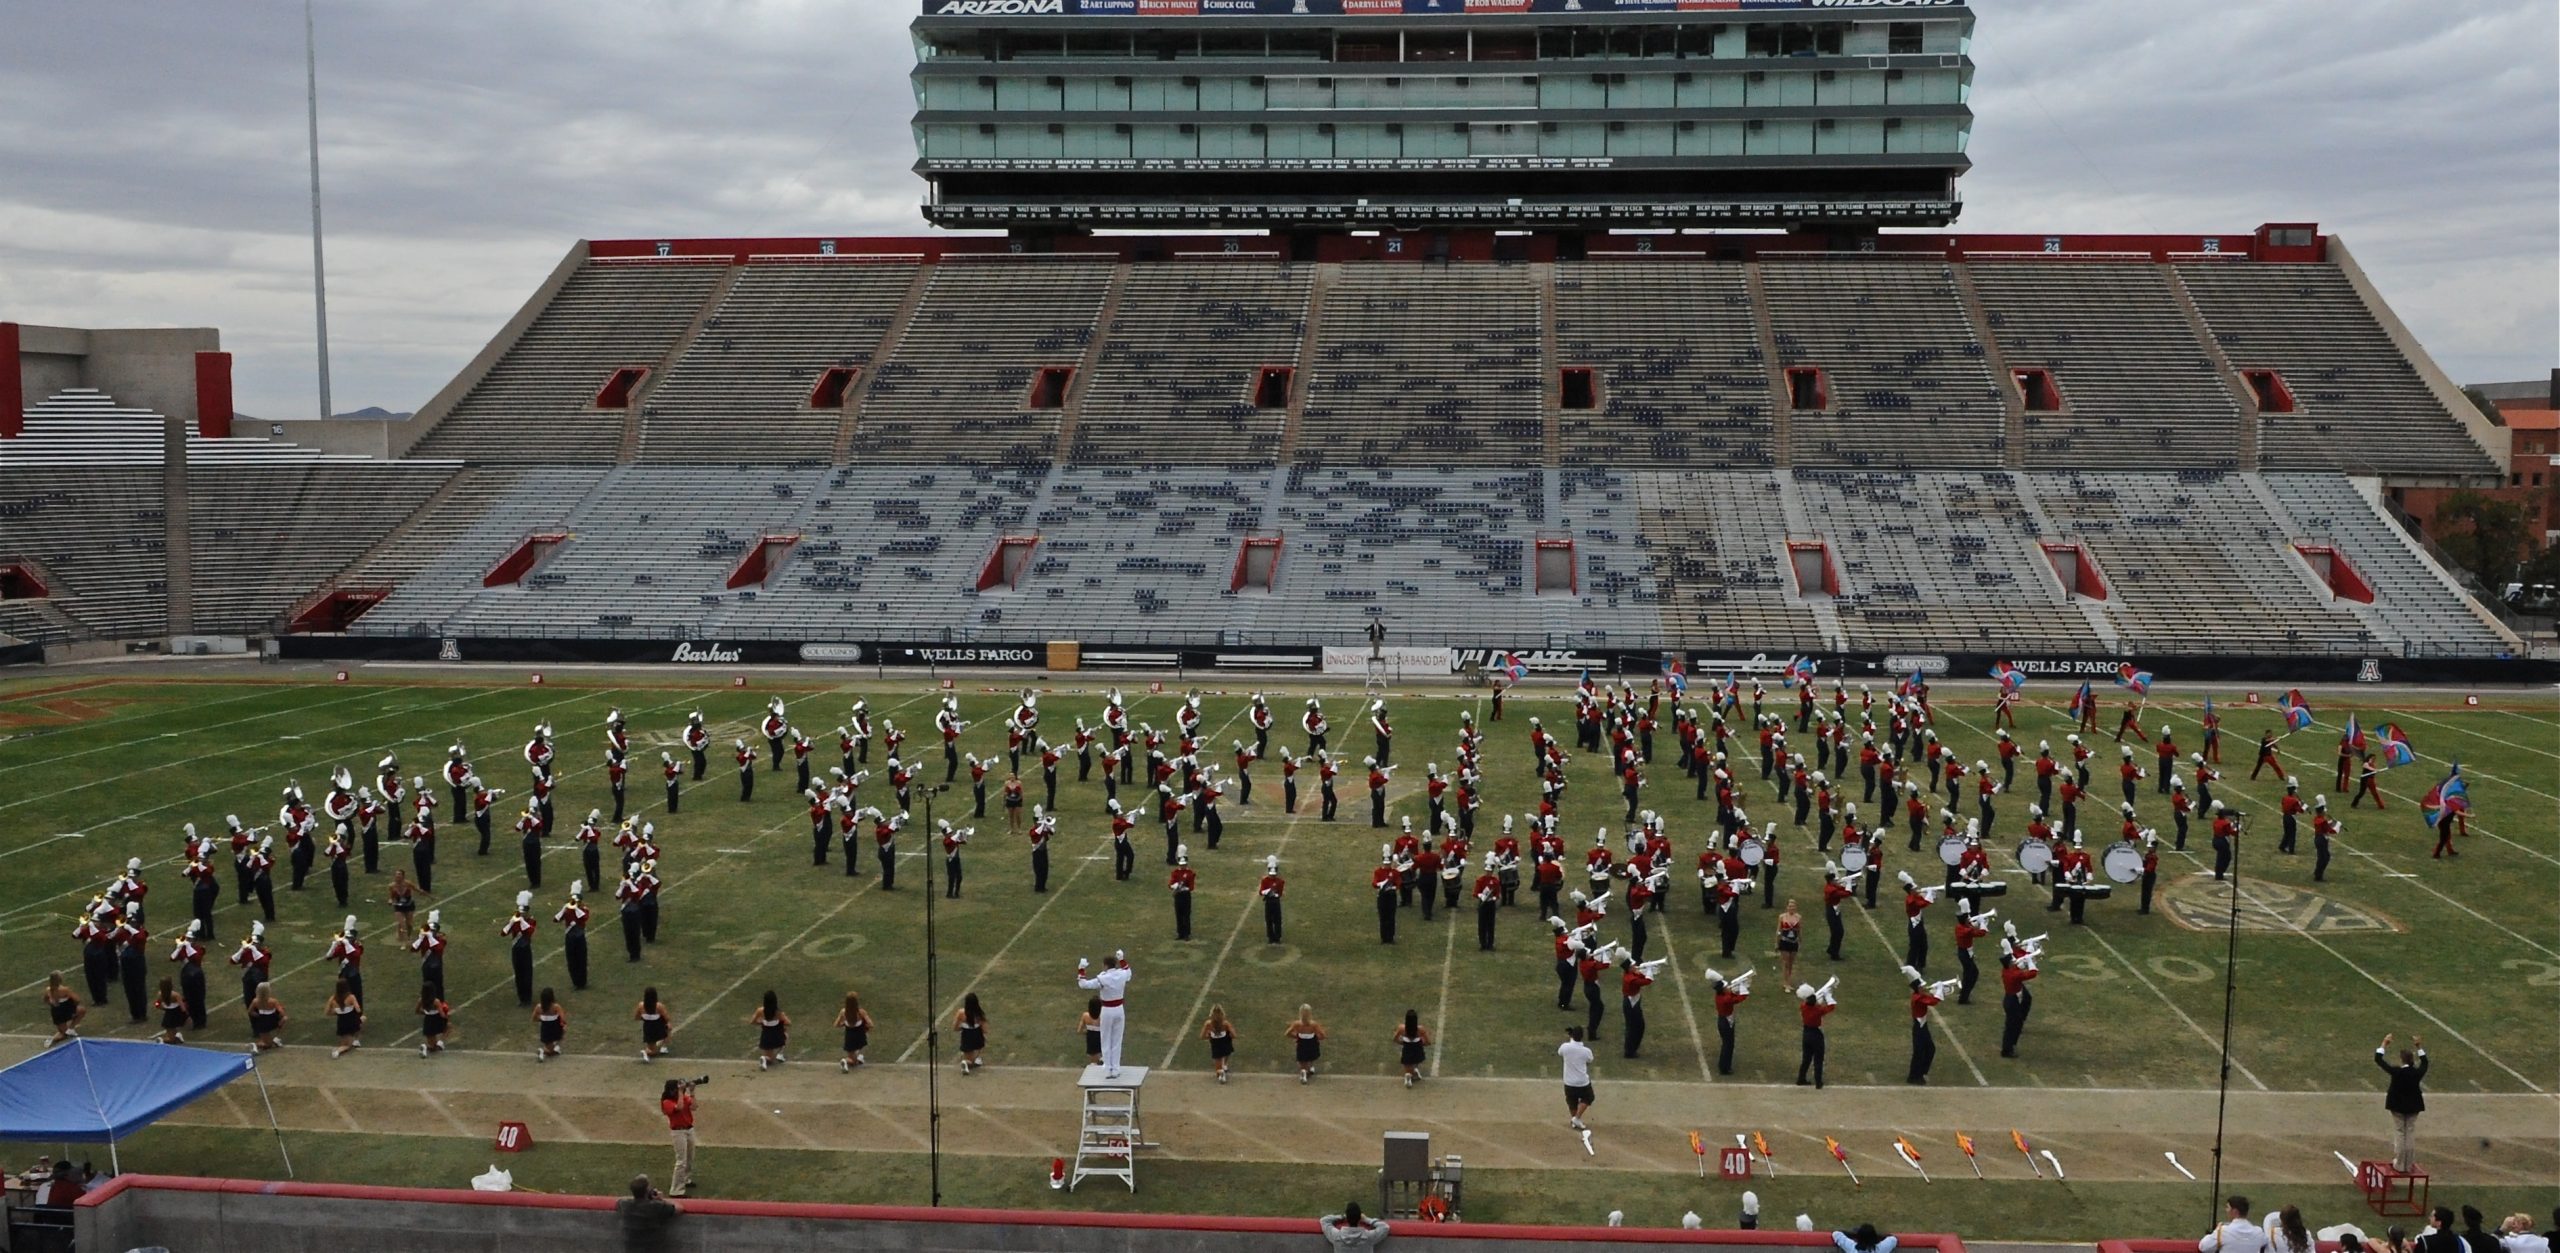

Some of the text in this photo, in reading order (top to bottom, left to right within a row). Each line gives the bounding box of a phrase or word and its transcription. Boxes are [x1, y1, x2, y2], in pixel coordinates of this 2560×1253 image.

[937, 0, 1062, 14] ARIZONA
[658, 247, 670, 256] 17
[822, 245, 834, 255] 18
[1224, 243, 1239, 252] 20
[1388, 242, 1401, 252] 21
[1637, 243, 1652, 252] 22
[2045, 243, 2060, 253] 24
[2203, 244, 2219, 254] 25
[272, 424, 284, 434] 16
[671, 642, 742, 662] Bashas'
[919, 649, 1034, 661] WELLS FARGO
[1411, 655, 1431, 666] BAND
[1433, 655, 1448, 666] DAY
[2011, 661, 2070, 673] WELLS
[2048, 954, 2215, 982] 30
[498, 1126, 518, 1148] 40
[1725, 1153, 1745, 1174] 40
